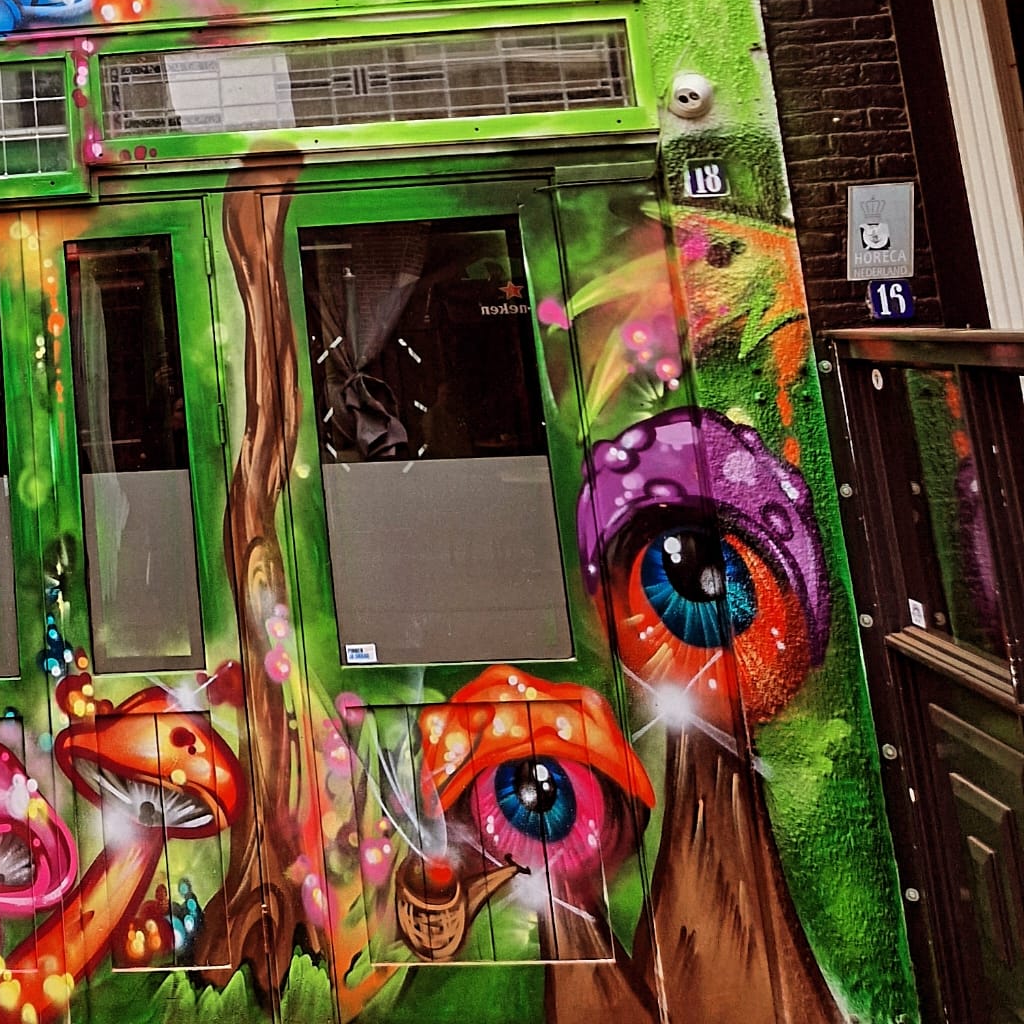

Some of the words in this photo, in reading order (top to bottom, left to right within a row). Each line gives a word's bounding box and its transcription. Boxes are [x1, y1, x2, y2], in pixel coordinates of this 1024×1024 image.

[694, 163, 722, 194] 18
[854, 249, 907, 265] HORECA
[853, 265, 908, 278] NEDERLAND
